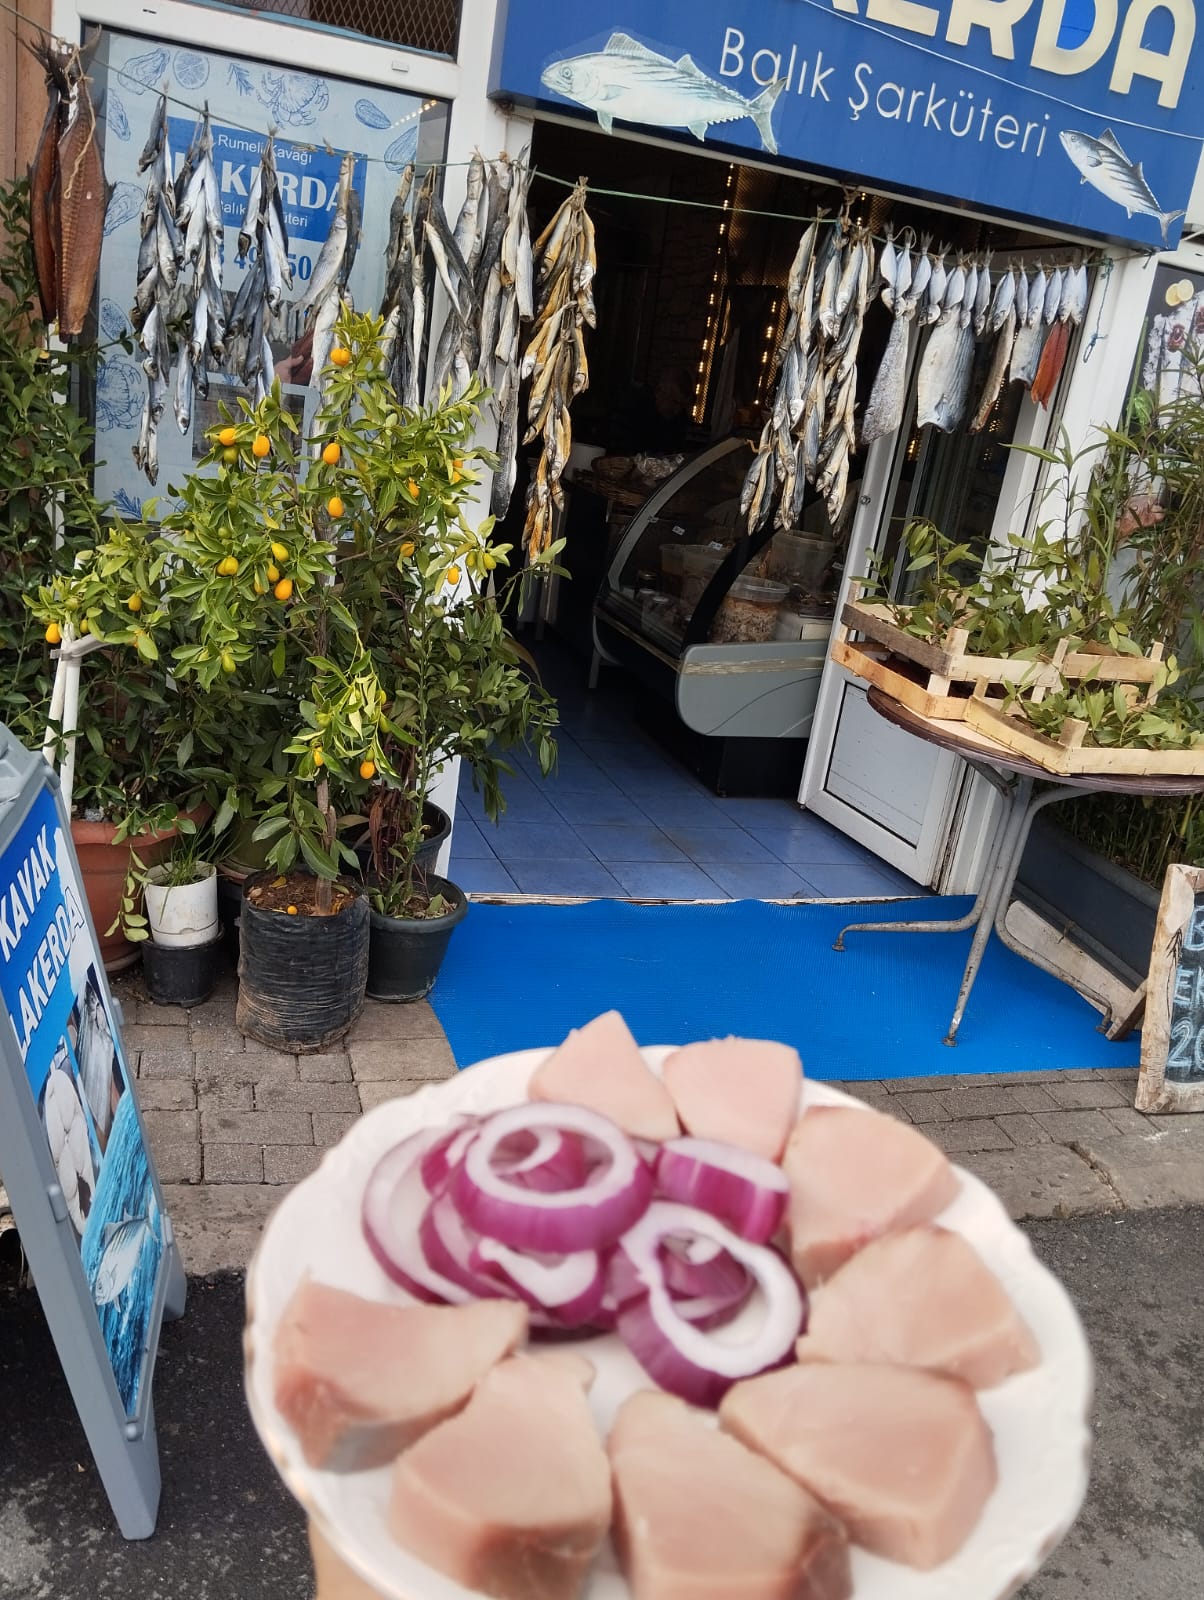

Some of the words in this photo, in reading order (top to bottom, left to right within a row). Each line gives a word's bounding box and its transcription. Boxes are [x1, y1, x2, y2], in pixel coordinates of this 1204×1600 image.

[218, 134, 264, 154] Rumeli
[719, 26, 835, 102] Balık
[848, 62, 1051, 158] Şarküteri
[0, 823, 56, 963] KAVAK
[9, 886, 86, 1065] LAKERDA
